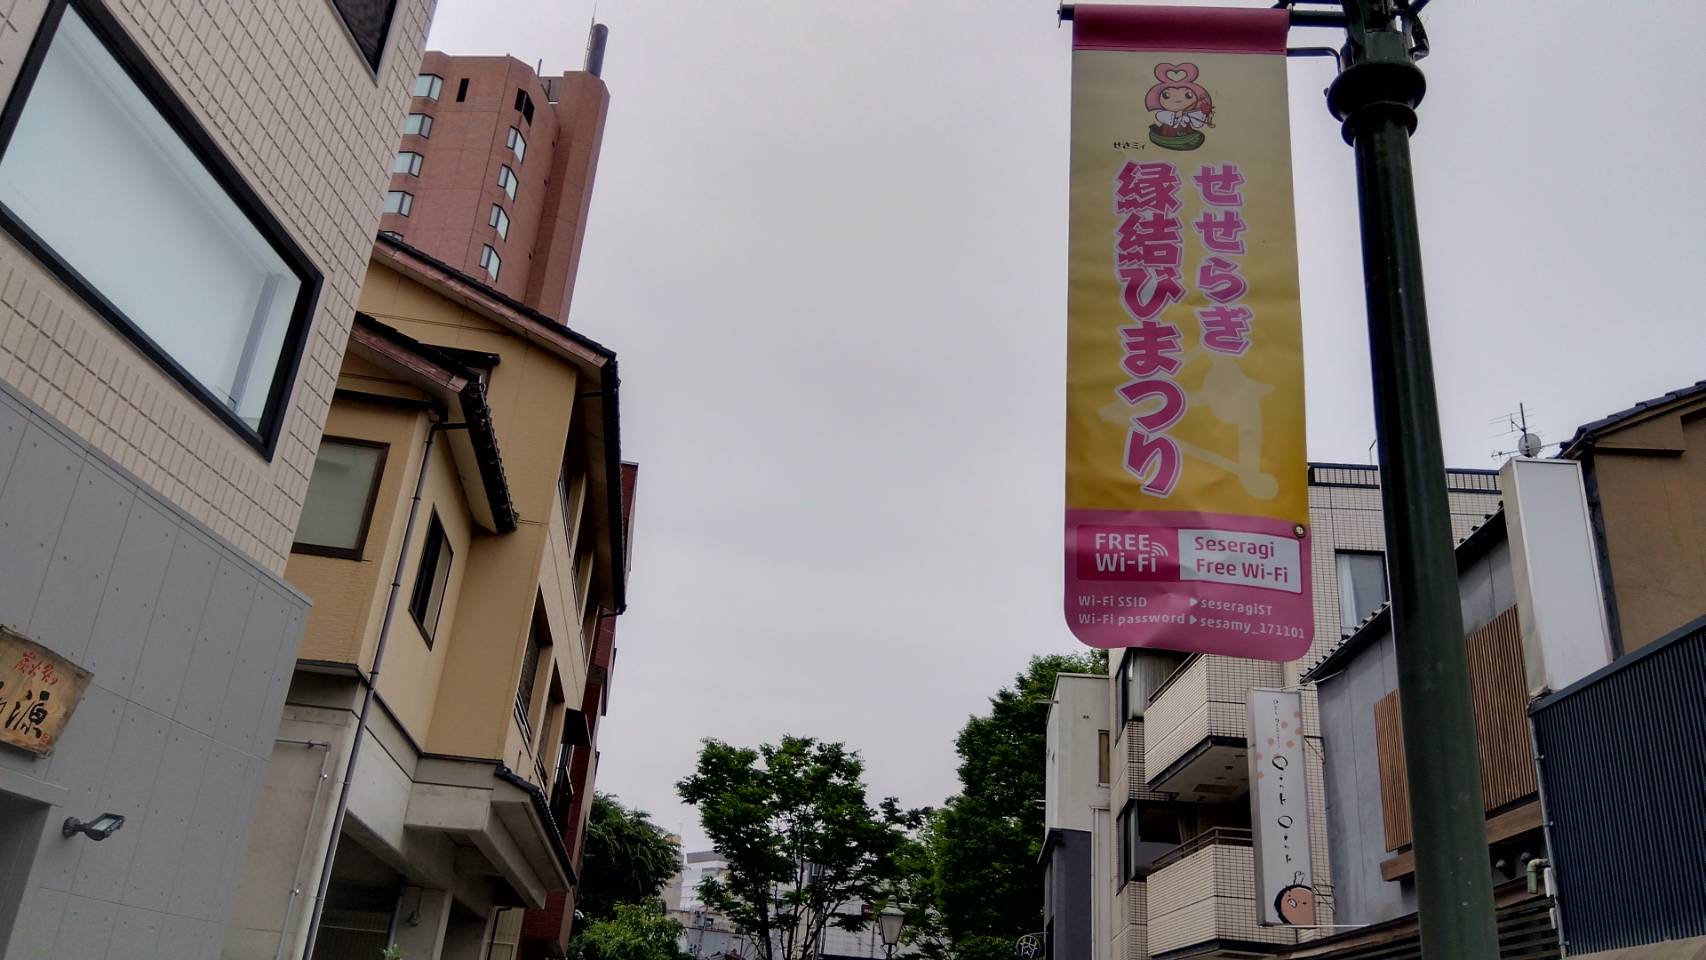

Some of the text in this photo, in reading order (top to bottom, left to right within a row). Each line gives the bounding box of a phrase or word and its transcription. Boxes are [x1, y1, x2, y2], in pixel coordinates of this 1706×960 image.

[1191, 163, 1253, 356] せせらぎ
[1115, 160, 1186, 497] 縁結びまつり
[1095, 533, 1150, 550] FREE
[1195, 536, 1275, 560] Seseragi
[1095, 552, 1156, 573] Wi-Fi
[1196, 558, 1288, 583] Free Wi-Fi
[1078, 595, 1273, 617] Wi-Fi SSID seseragiST
[1078, 612, 1305, 640] Wi-Fi password sesamy_171101
